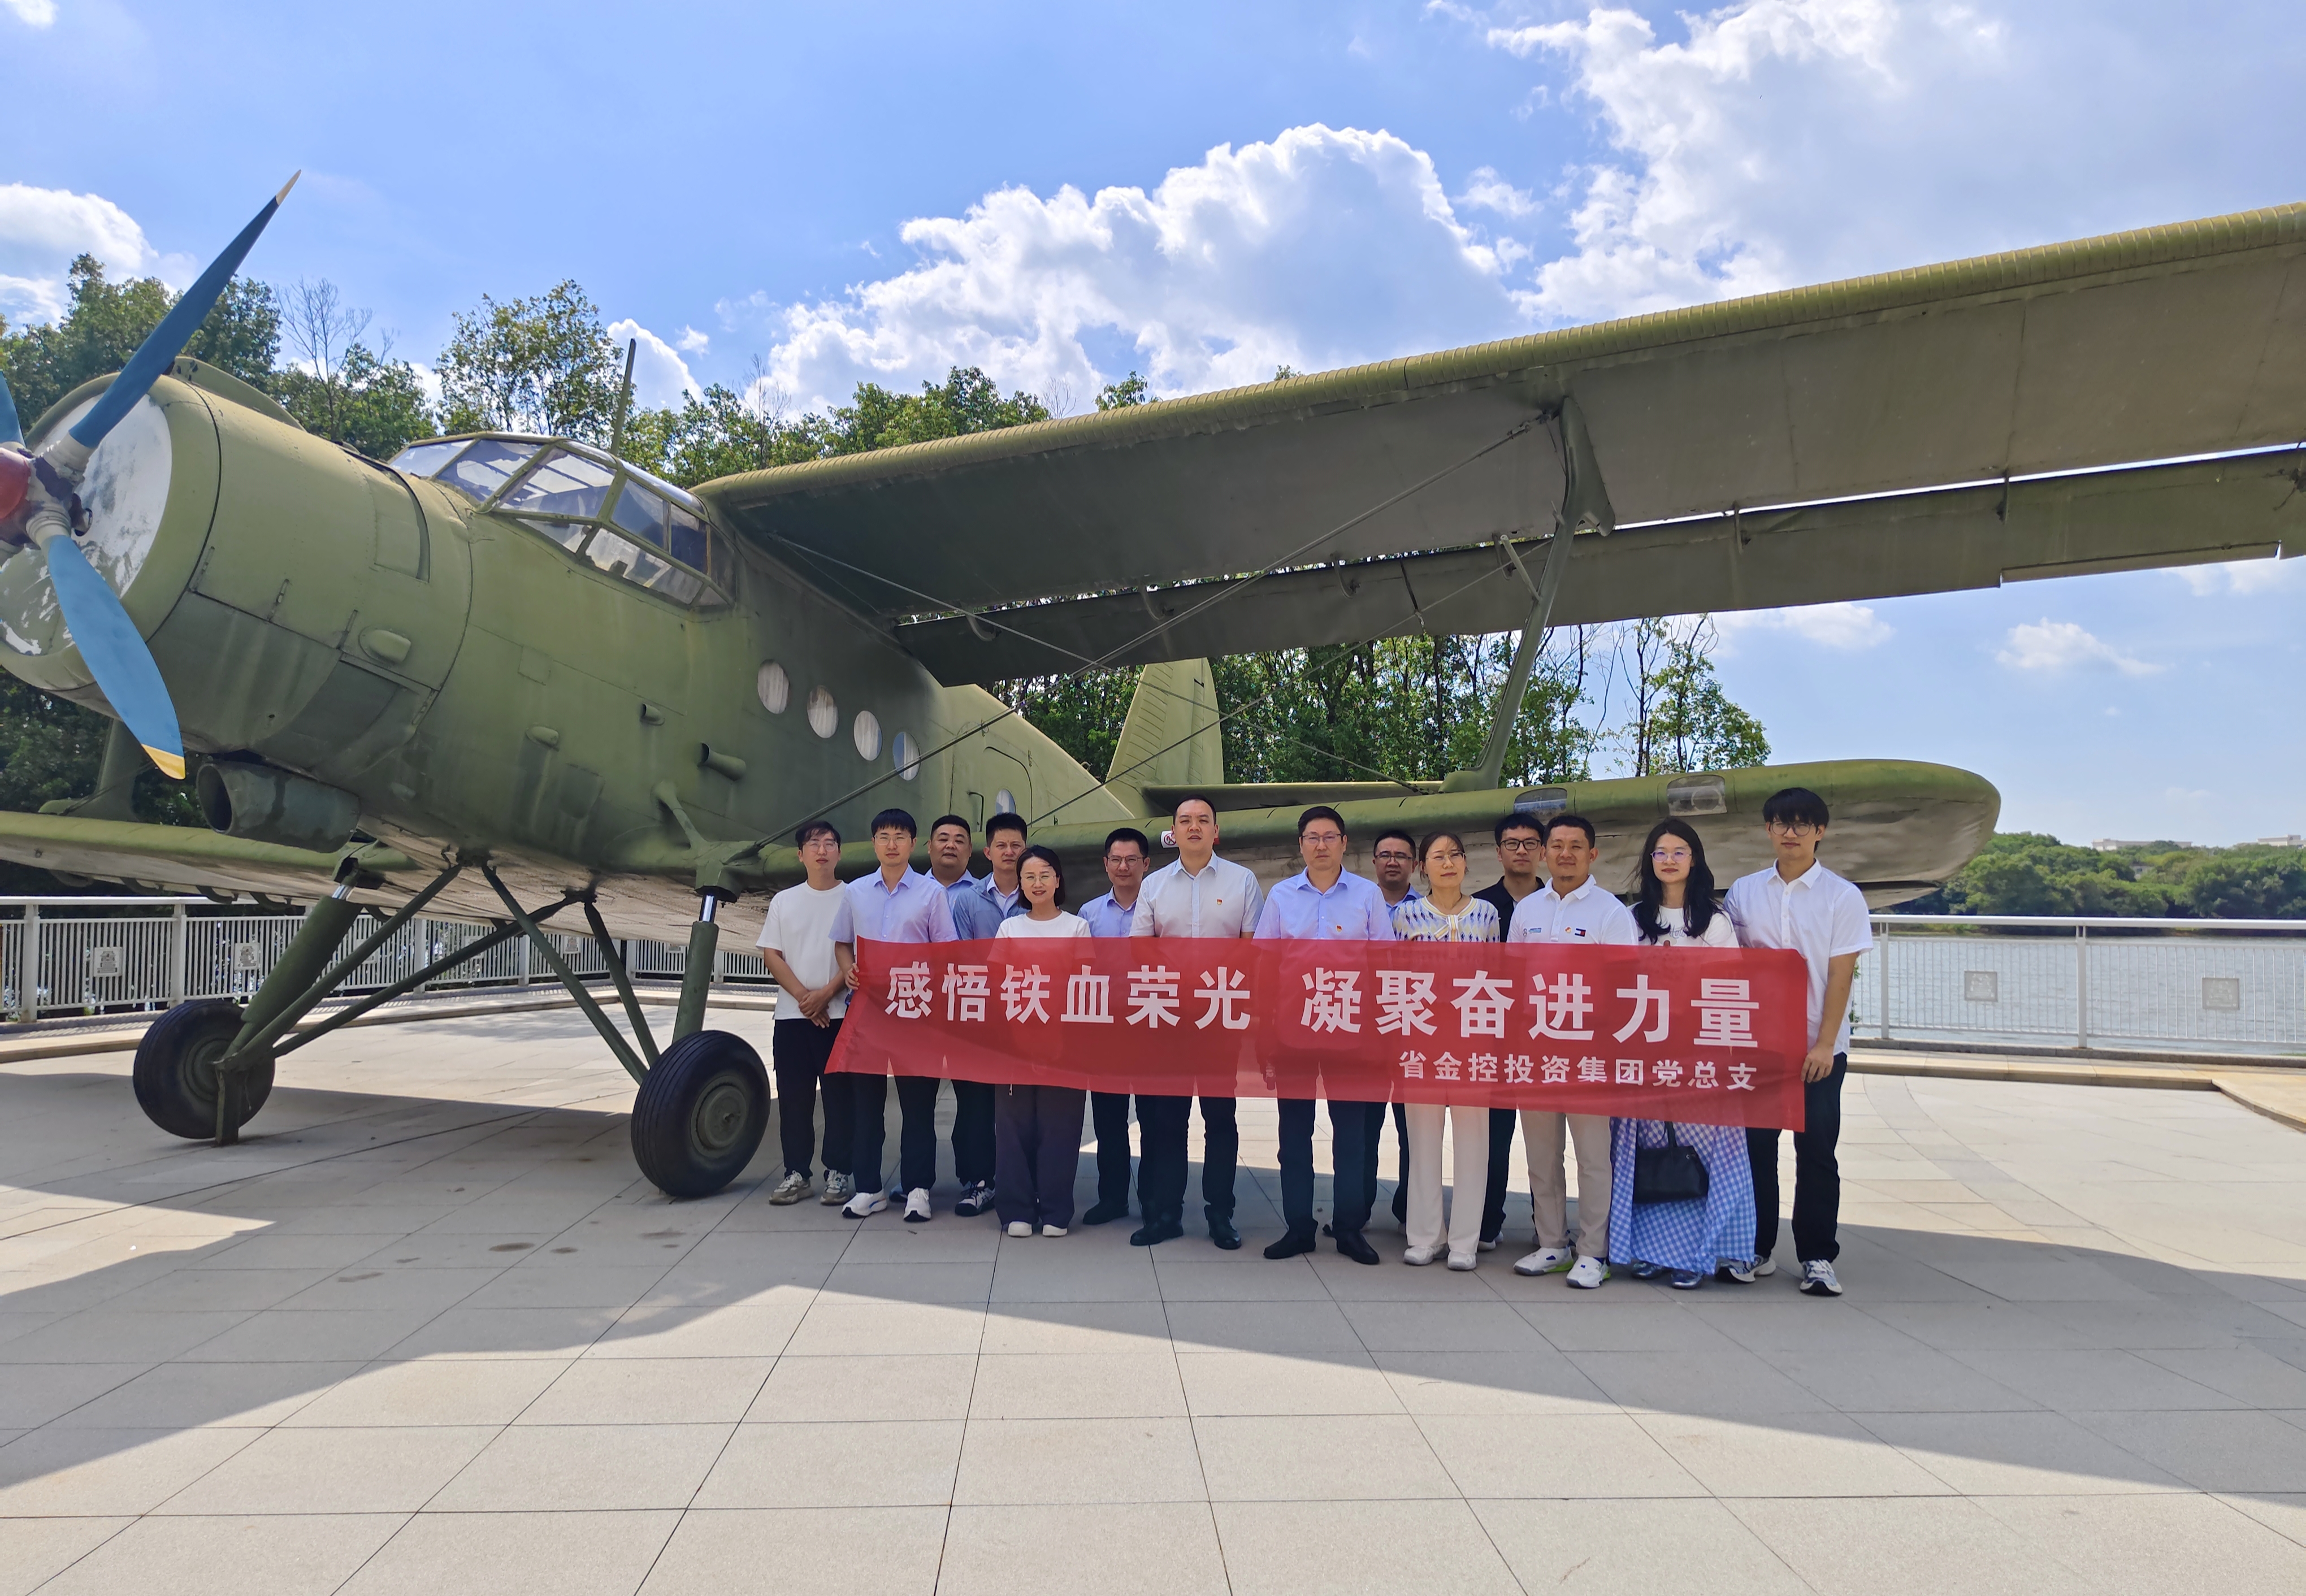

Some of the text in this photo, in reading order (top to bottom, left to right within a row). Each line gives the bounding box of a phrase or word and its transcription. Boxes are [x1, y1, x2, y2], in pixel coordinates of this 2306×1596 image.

[885, 961, 1759, 1048] 感悟铁血荣光 凝聚奋进力量
[1399, 1051, 1757, 1091] 省金控投资集团党总支
